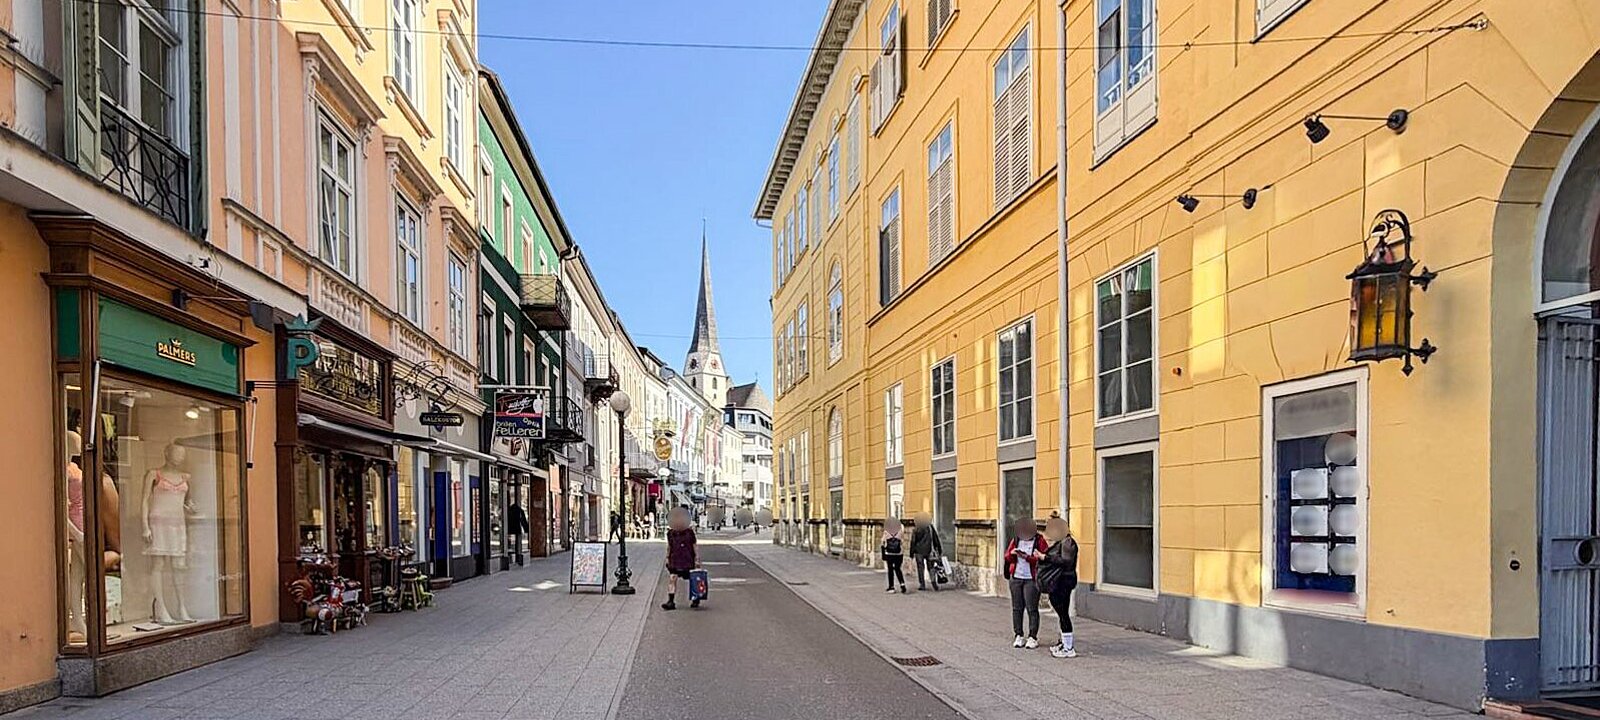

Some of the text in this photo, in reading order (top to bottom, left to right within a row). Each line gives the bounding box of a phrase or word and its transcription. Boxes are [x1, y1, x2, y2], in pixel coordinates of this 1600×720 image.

[158, 342, 196, 363] PALMERS
[287, 337, 317, 379] P
[496, 427, 542, 437] fellerer
